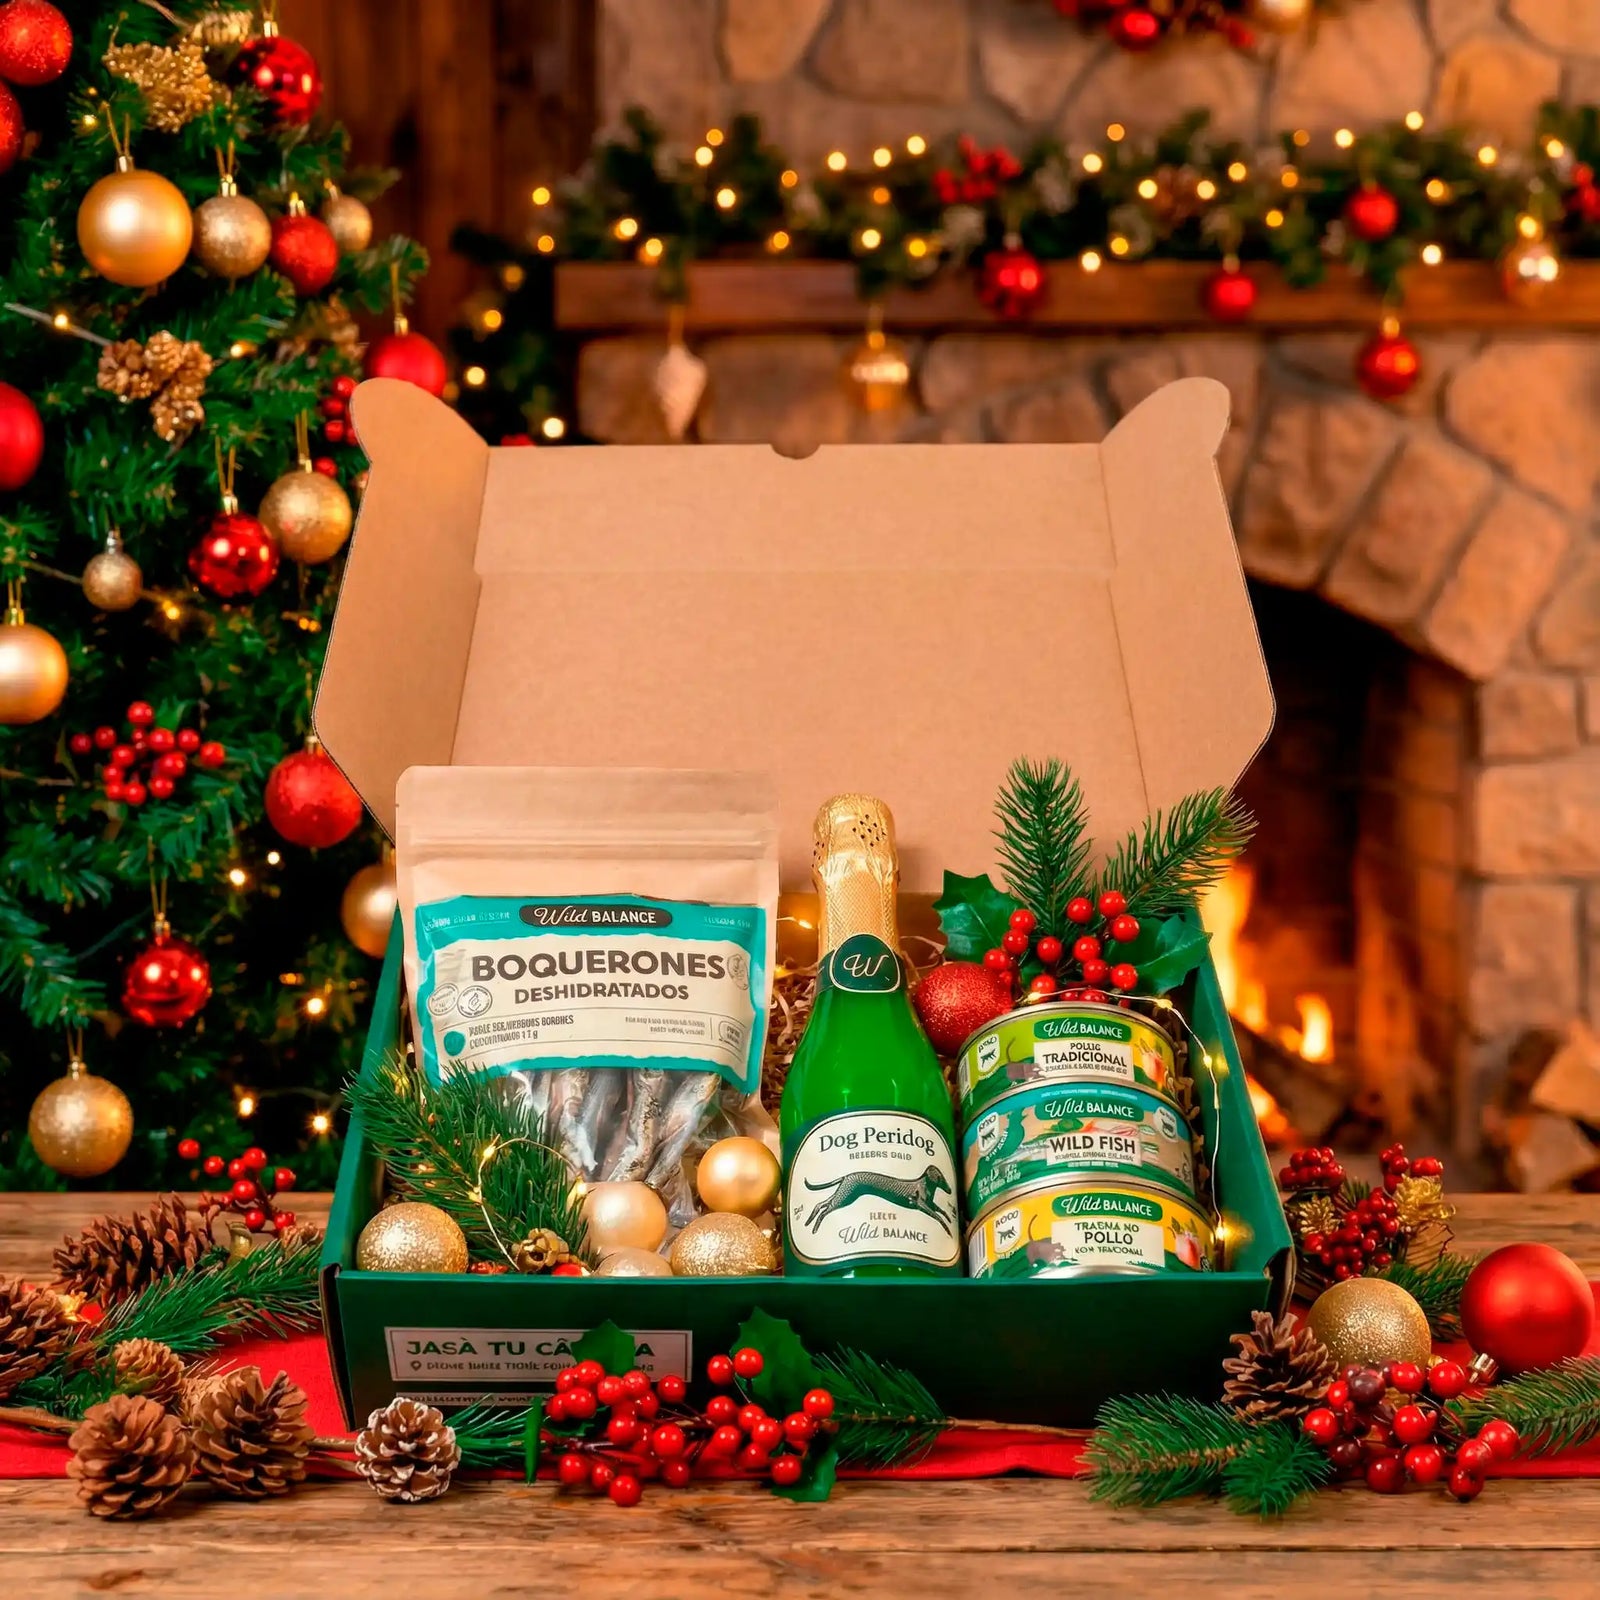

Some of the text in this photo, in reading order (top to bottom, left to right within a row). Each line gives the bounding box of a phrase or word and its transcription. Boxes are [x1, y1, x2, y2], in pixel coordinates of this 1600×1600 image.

[534, 905, 657, 926] Wild BALANCE
[472, 950, 726, 982] BOQUERONES
[515, 982, 689, 1004] DESHIDRATADOS
[1043, 1018, 1123, 1039] Wild BALANCE
[1043, 1051, 1128, 1068] TRADICIONAL
[1045, 1098, 1135, 1118] Wild BALANCE
[819, 1126, 936, 1157] Dog Peridog
[1050, 1135, 1135, 1154] WILD FISH
[1060, 1195, 1153, 1217] Wild BALANCE
[838, 1221, 929, 1245] Wild BALANCE
[1084, 1231, 1133, 1245] POLLO
[406, 1337, 478, 1356] JASÀ
[488, 1341, 526, 1356] TU
